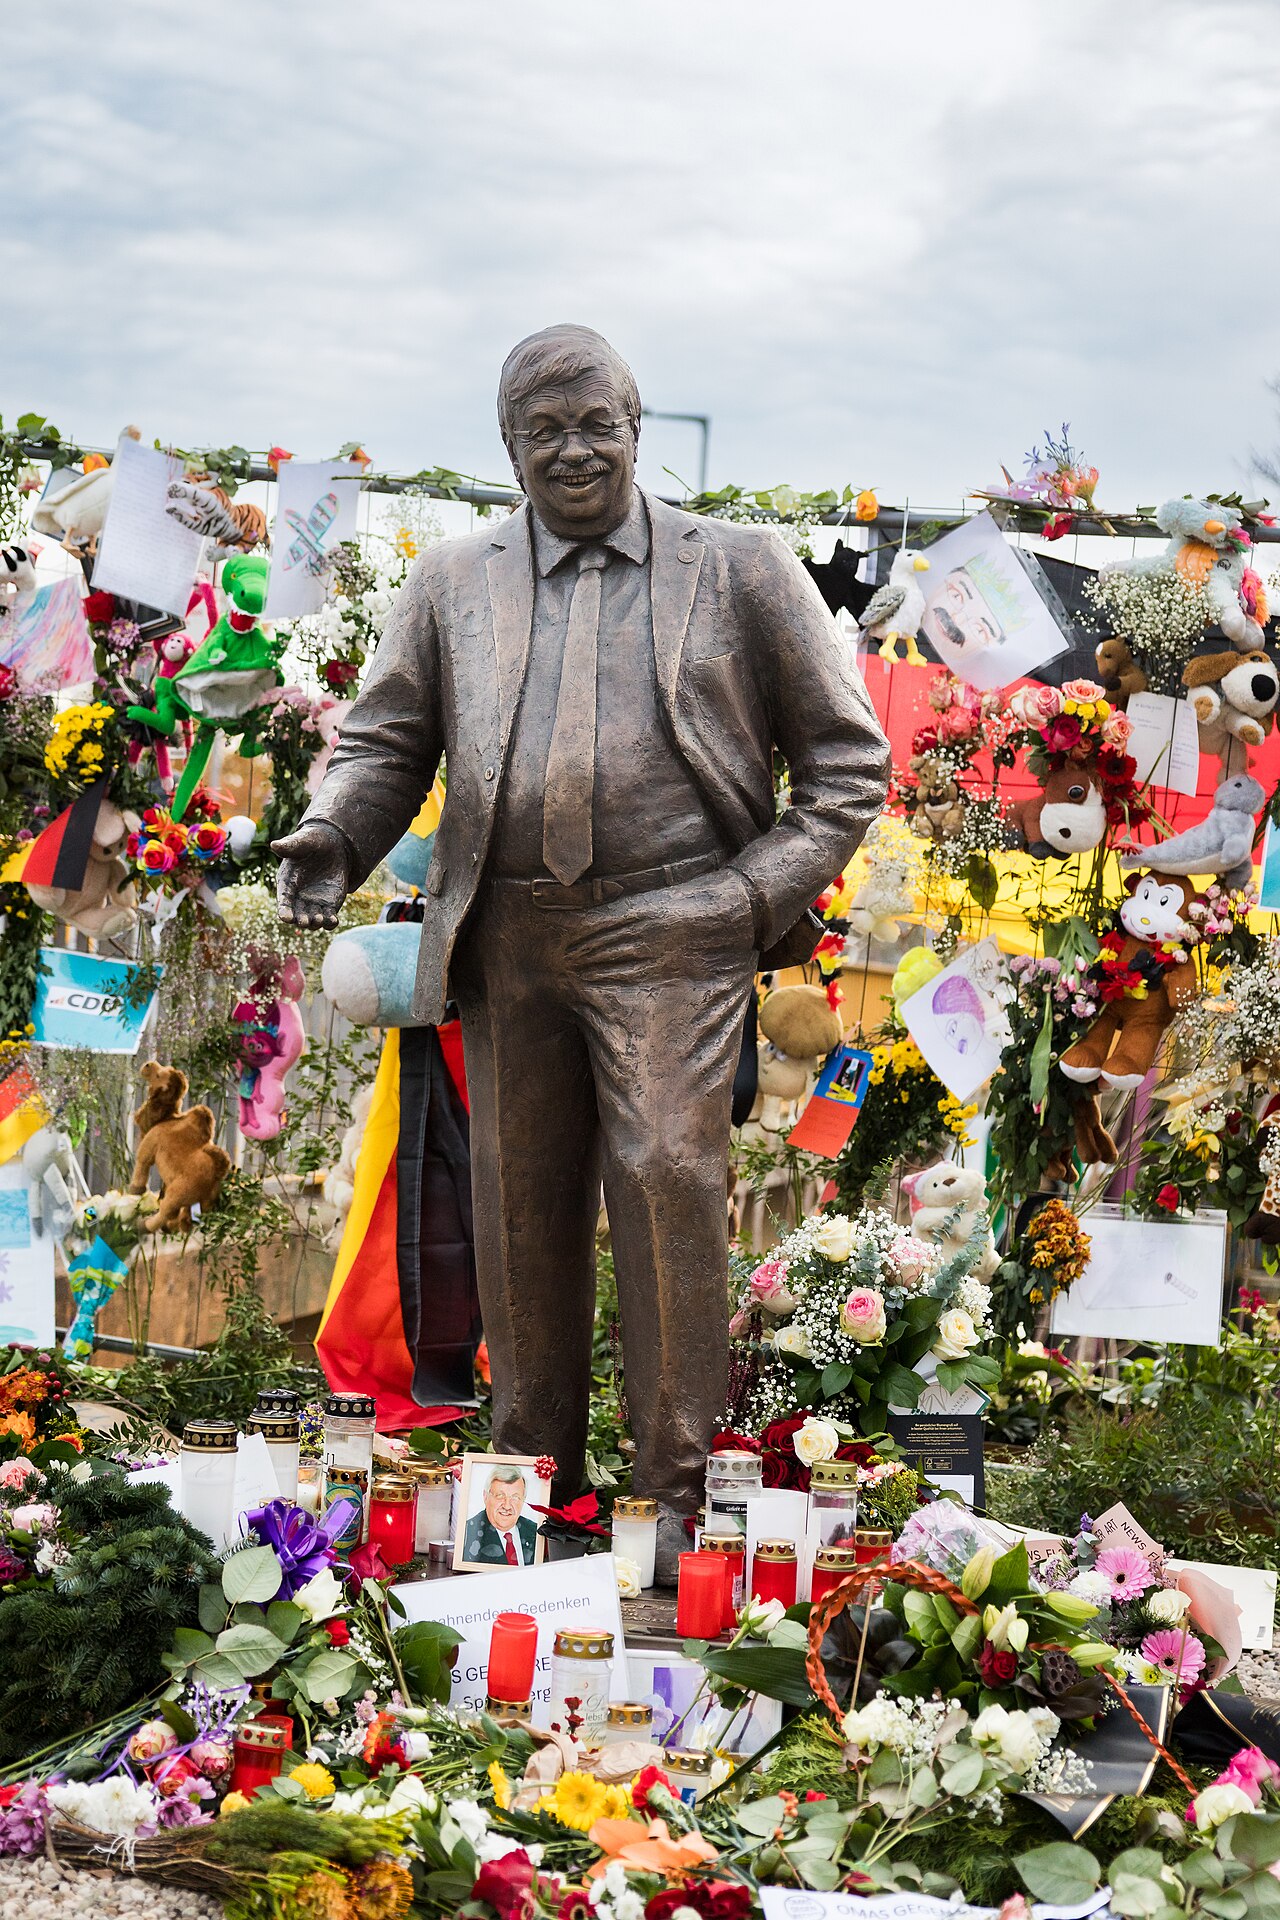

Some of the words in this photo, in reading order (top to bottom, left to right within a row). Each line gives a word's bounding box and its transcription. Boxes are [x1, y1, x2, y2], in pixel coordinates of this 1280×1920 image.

[1104, 1519, 1118, 1535] ART
[1120, 1521, 1147, 1551] NEWS
[431, 1608, 513, 1627] ahnende
[518, 1597, 590, 1615] Gedenken
[836, 1904, 890, 1919] OMAS
